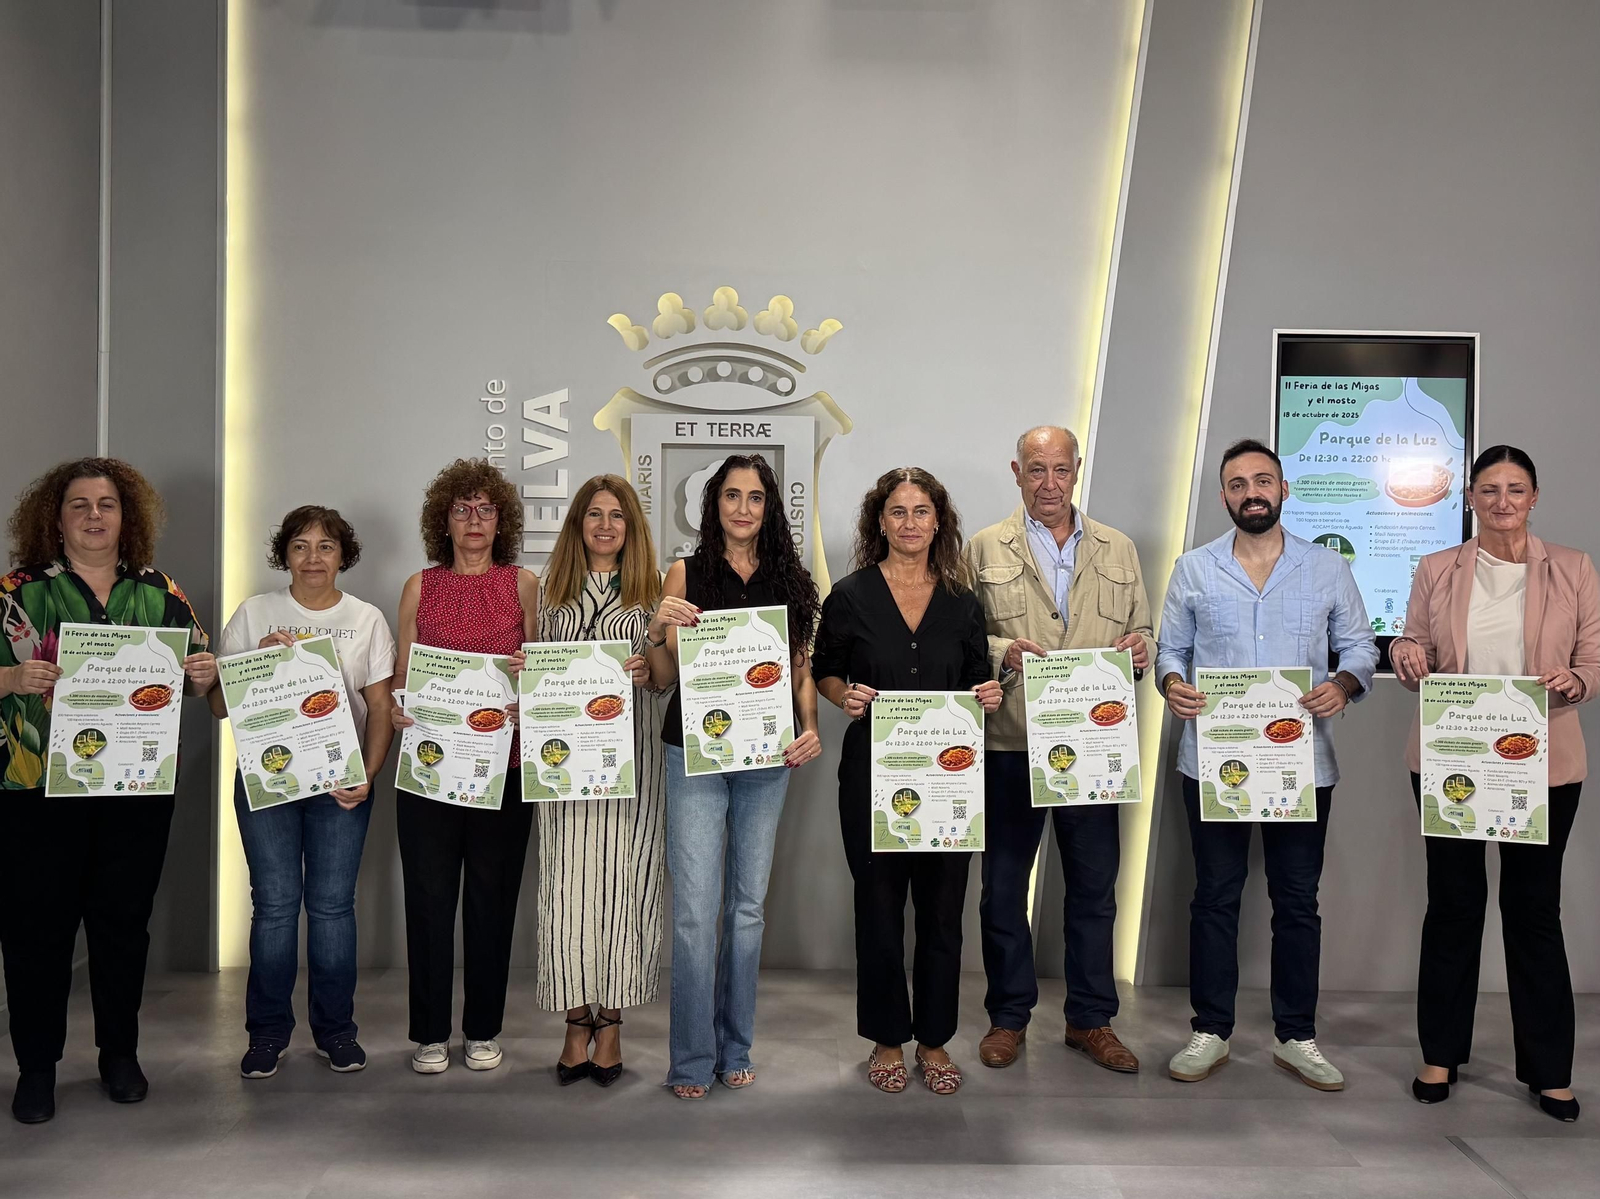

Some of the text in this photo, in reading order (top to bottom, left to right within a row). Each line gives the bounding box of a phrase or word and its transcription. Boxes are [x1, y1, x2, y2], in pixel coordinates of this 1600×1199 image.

[1294, 382, 1318, 390] Feria
[1321, 382, 1332, 390] de
[1335, 382, 1348, 390] las
[1351, 382, 1380, 392] Migas
[480, 380, 505, 414] de
[1308, 398, 1313, 407] y
[675, 422, 772, 438] ET TERRÆ
[1320, 432, 1437, 448] Parque de la Luz
[1299, 454, 1312, 462] De
[1314, 454, 1338, 462] 12:30
[638, 454, 652, 515] MARIS
[704, 648, 734, 657] Parque
[87, 664, 166, 675] Parque de la Luz
[252, 674, 324, 696] Parque de la Luz
[544, 678, 575, 687] Parque
[430, 683, 461, 695] Parque
[487, 690, 501, 698] Luz
[1049, 686, 1078, 694] Parque
[1222, 702, 1254, 710] Parque
[1449, 711, 1482, 722] Parque
[1486, 713, 1497, 721] de
[1511, 714, 1527, 722] Luz
[897, 728, 928, 737] Parque
